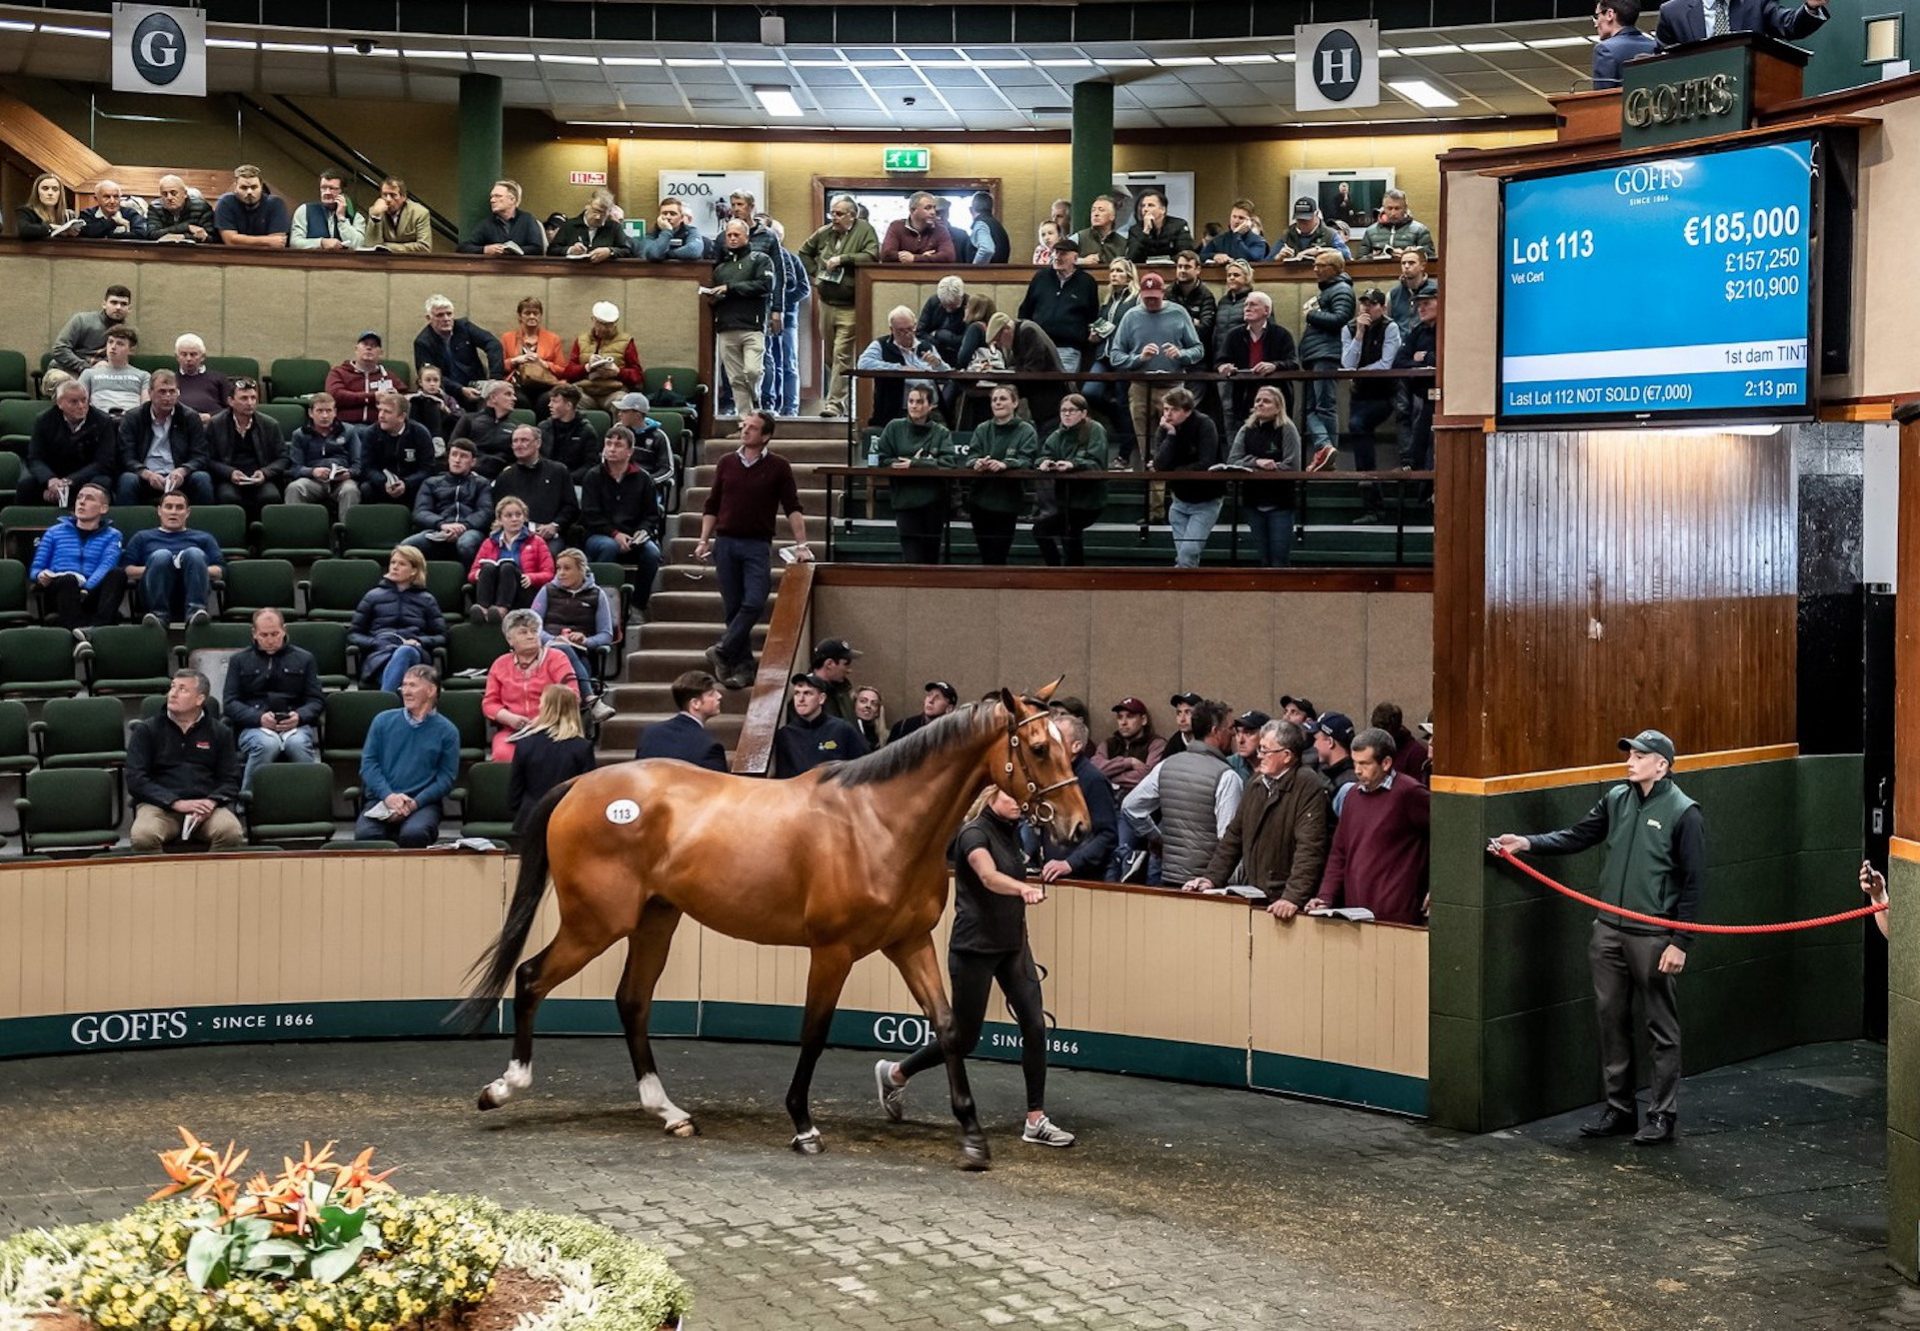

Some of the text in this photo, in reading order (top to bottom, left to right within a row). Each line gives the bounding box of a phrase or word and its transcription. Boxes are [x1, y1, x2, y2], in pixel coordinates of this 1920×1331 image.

[140, 30, 178, 67] G
[1319, 47, 1355, 86] H
[1624, 73, 1734, 127] GOFFS
[1614, 166, 1683, 196] GOFFS
[1629, 197, 1651, 206] SINCE
[1683, 204, 1800, 246] €185,000
[1512, 229, 1594, 265] Lot 113
[1725, 246, 1800, 273] £157,250
[1510, 270, 1545, 284] Vet Cert
[1725, 274, 1799, 302] $210,900
[1724, 344, 1807, 364] 1st dam TINT
[1509, 383, 1692, 406] Last Lot 112 NOT SOLD (€7,000)
[1744, 379, 1797, 399] 2:13 pm
[613, 808, 631, 820] 113
[70, 1011, 314, 1045] GOFFS SINCE 1866
[873, 1015, 937, 1046] GOF
[1046, 1039, 1079, 1054] 1866
